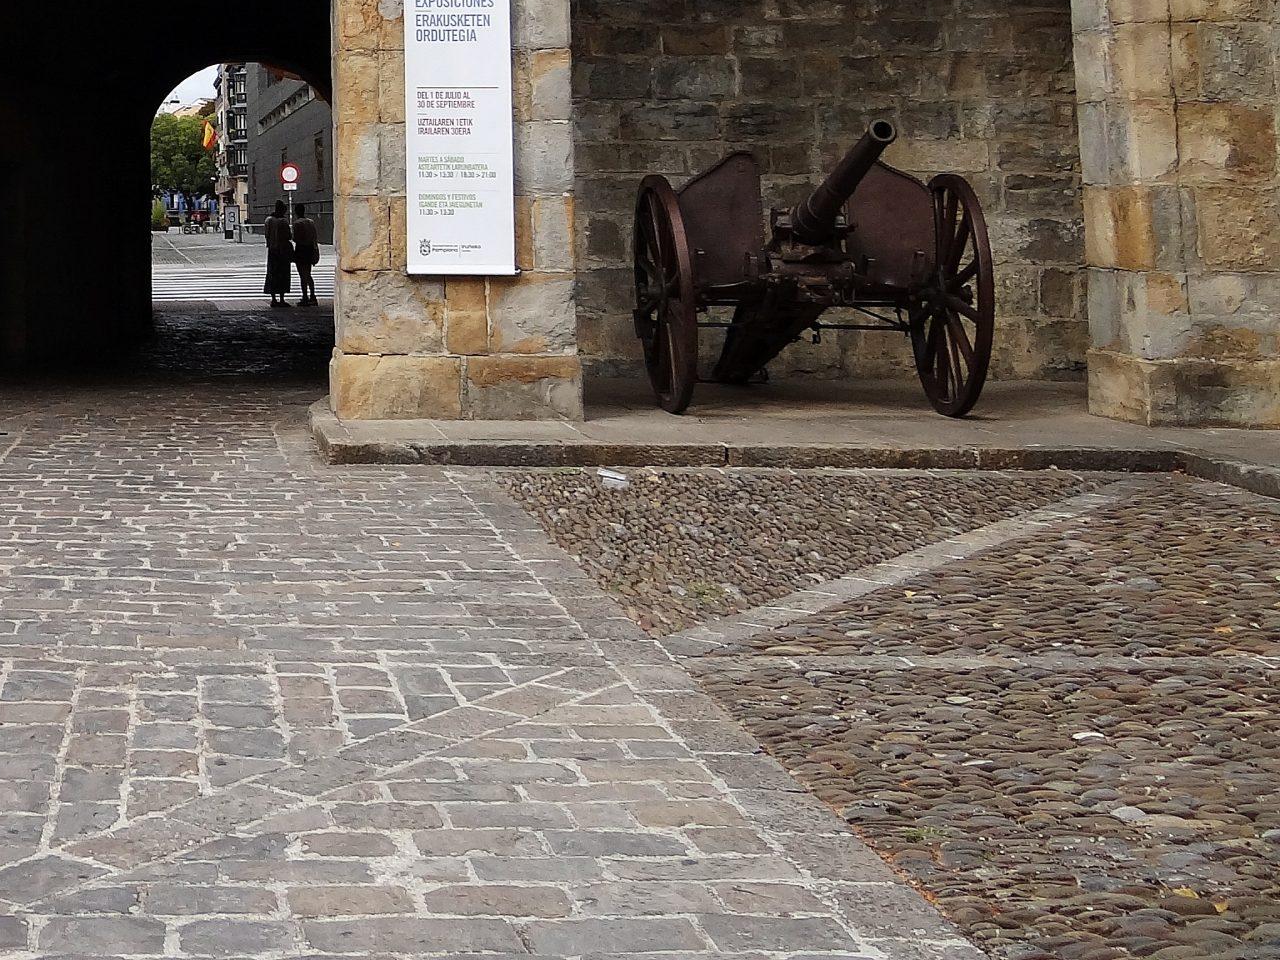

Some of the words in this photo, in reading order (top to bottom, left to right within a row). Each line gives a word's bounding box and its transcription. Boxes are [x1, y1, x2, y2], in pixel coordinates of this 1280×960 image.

[416, 14, 490, 26] ERAKUSKETEN
[416, 29, 476, 41] ORDUTEGIA
[229, 212, 235, 222] 3
